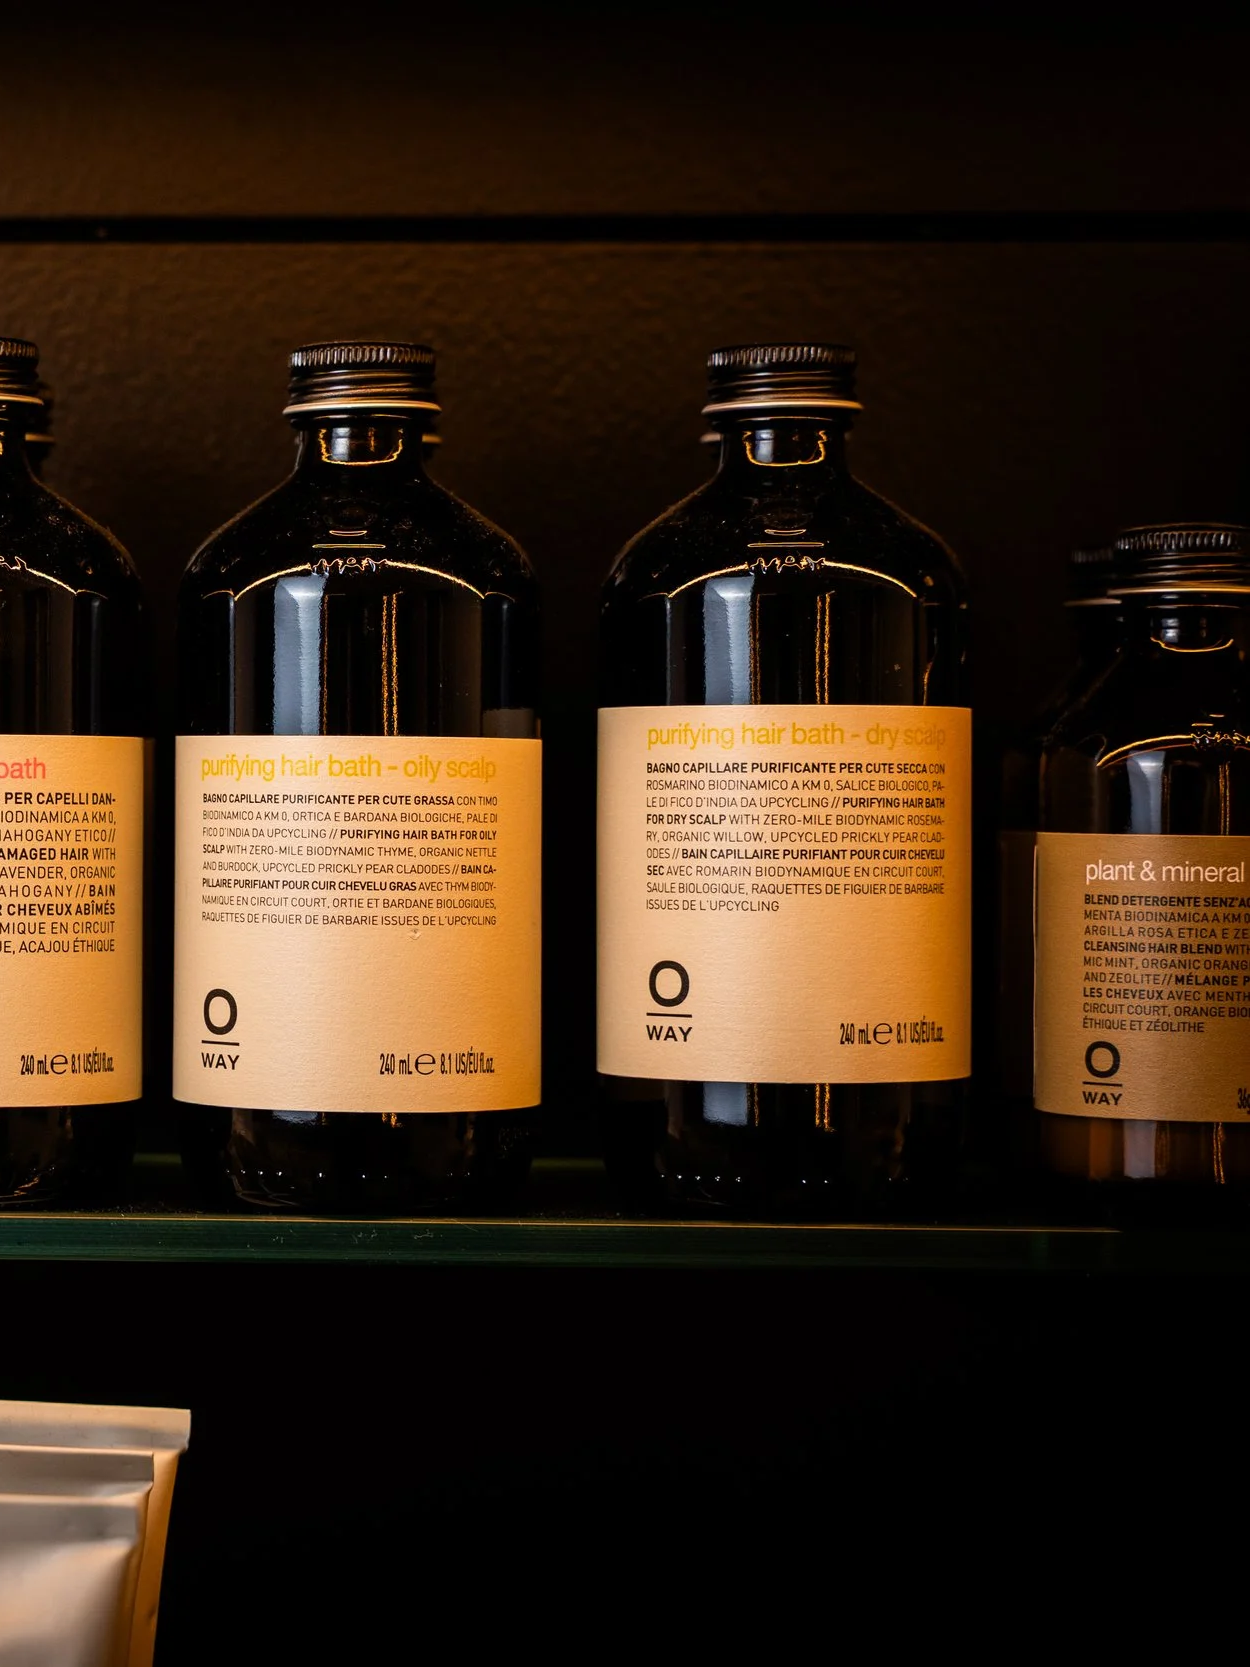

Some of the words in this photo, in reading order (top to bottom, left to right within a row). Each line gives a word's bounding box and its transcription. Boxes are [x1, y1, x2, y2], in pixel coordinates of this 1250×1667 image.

[647, 722, 734, 750] purifying
[742, 723, 785, 744] hair
[792, 723, 844, 745] bath
[866, 724, 898, 750] dry
[904, 724, 946, 751] scalp
[201, 755, 275, 782] purifying
[281, 755, 323, 777] hair
[329, 755, 381, 777] bath
[403, 755, 442, 783] oily
[446, 756, 496, 782] scalp
[647, 763, 680, 773] BAGNO
[683, 763, 747, 774] CAPILLARE
[751, 762, 836, 774] PURIFICANTE
[840, 763, 862, 774] PER
[866, 763, 894, 774] CUTE
[897, 763, 927, 774] SECCA
[929, 763, 945, 774] CON
[4, 793, 32, 804] PER
[36, 793, 89, 805] CAPELLI
[92, 793, 116, 806] DAN-
[203, 793, 227, 803] BAGNO
[229, 794, 279, 804] CAPILLARE
[282, 794, 355, 805] PURIFICANTE
[358, 795, 380, 805] PER
[383, 795, 411, 805] CUTE
[414, 796, 455, 806] GRASSA
[457, 796, 476, 806] CON
[478, 796, 497, 806] TIMO
[71, 866, 115, 879] ORGANIC
[1086, 859, 1135, 885] plant
[1140, 861, 1155, 880] &
[1162, 862, 1244, 883] mineral
[7, 904, 72, 916] CHEVEUX
[75, 900, 115, 915] ABÎMÉS
[646, 899, 679, 911] ISSUES
[682, 900, 696, 911] DE
[1085, 895, 1118, 905] BLEND
[1122, 895, 1200, 907] DETERGENTE
[202, 912, 245, 924] RAQUETTES
[247, 913, 259, 923] DE
[262, 913, 302, 924] FIGUIER
[305, 914, 319, 925] DE
[322, 915, 378, 925] BARBARIE
[381, 915, 419, 926] ISSUES
[422, 915, 436, 926] DE
[19, 940, 70, 953] ACAJOU
[73, 937, 115, 953] ÉTHIQUE
[649, 960, 690, 1007] O
[204, 988, 237, 1035] O
[1083, 1003, 1124, 1014] CIRCUIT
[1127, 1004, 1170, 1017] COURT,
[1174, 1006, 1225, 1017] ORANGE
[1083, 1016, 1126, 1030] ÉTHIQUE
[1130, 1020, 1143, 1030] ET
[1146, 1019, 1204, 1033] ZÉOLITHE
[646, 1025, 692, 1042] WAY
[840, 1023, 854, 1045] 240
[858, 1023, 871, 1045] mL
[897, 1023, 907, 1044] 8.1
[20, 1055, 34, 1075] 240
[37, 1056, 49, 1075] mL
[71, 1054, 81, 1074] 8.1
[201, 1053, 239, 1070] WAY
[380, 1053, 395, 1075] 240
[399, 1054, 412, 1075] mL
[440, 1053, 451, 1074] 8.1
[1085, 1041, 1120, 1078] O
[1082, 1091, 1122, 1105] WAY
